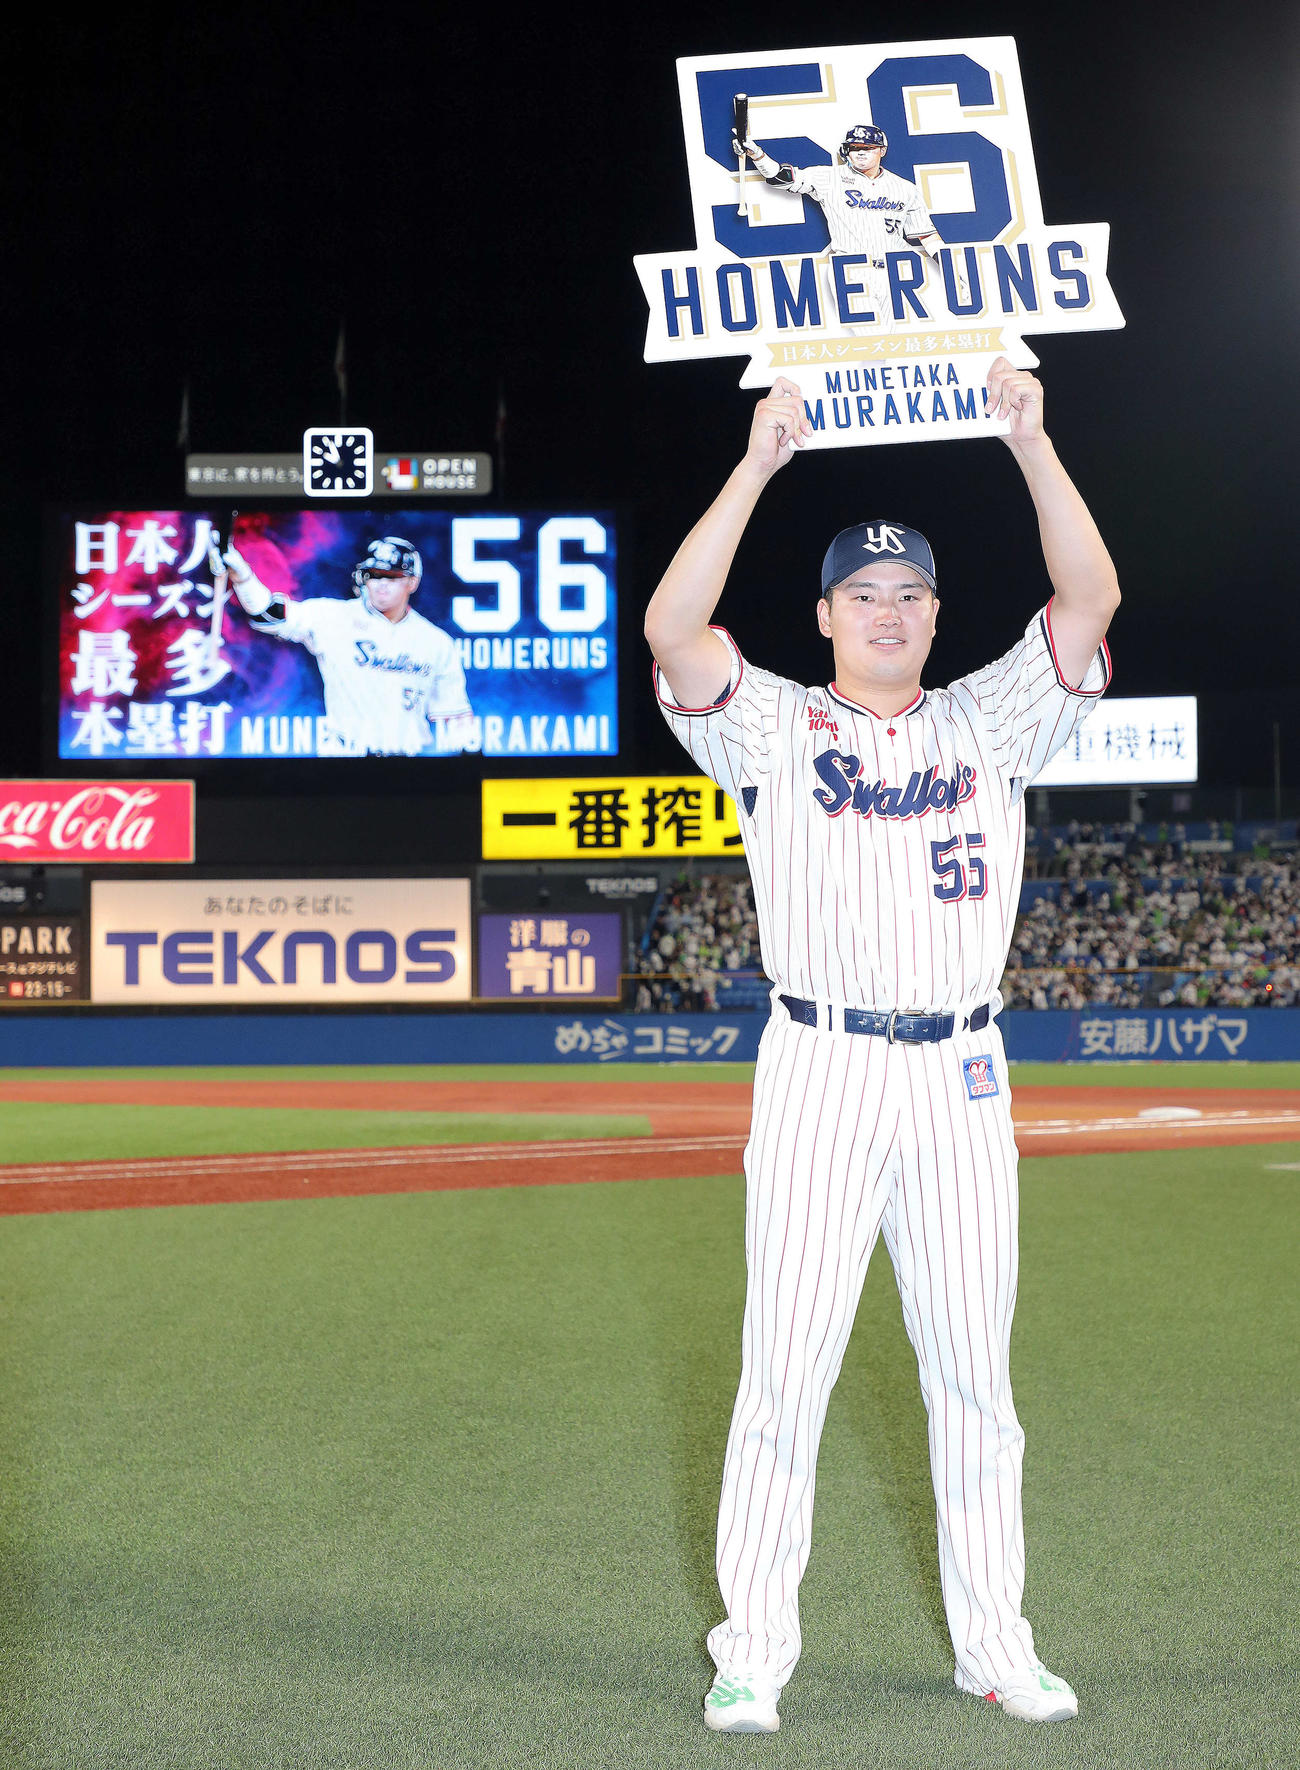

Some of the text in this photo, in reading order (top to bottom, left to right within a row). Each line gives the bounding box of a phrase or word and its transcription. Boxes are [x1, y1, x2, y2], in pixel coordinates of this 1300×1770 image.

[695, 54, 1013, 259] 56
[844, 189, 905, 212] Swallows
[661, 240, 1092, 338] HOMERUNS
[783, 332, 992, 362] 日本人シーズン最多本塁打
[825, 362, 960, 394] MUNETAKA
[423, 458, 477, 475] OPEN
[423, 474, 477, 489] HOUSE
[74, 519, 222, 575] 日本人
[452, 517, 607, 633] 56
[70, 579, 235, 620] シーズン
[455, 637, 608, 670] HOMERUNS
[70, 701, 234, 756] 本塁打
[813, 748, 978, 820] Swallows
[585, 877, 658, 894] TEKNOS
[930, 832, 987, 904] 55
[203, 896, 354, 916] あなたのそばに
[1, 926, 73, 955] PARK
[509, 918, 591, 948] 洋服の
[105, 930, 457, 986] TEKNOS
[505, 949, 597, 995] 青山
[554, 1020, 741, 1058] めちゃコミック
[1079, 1015, 1249, 1057] 安藤ハザマ
